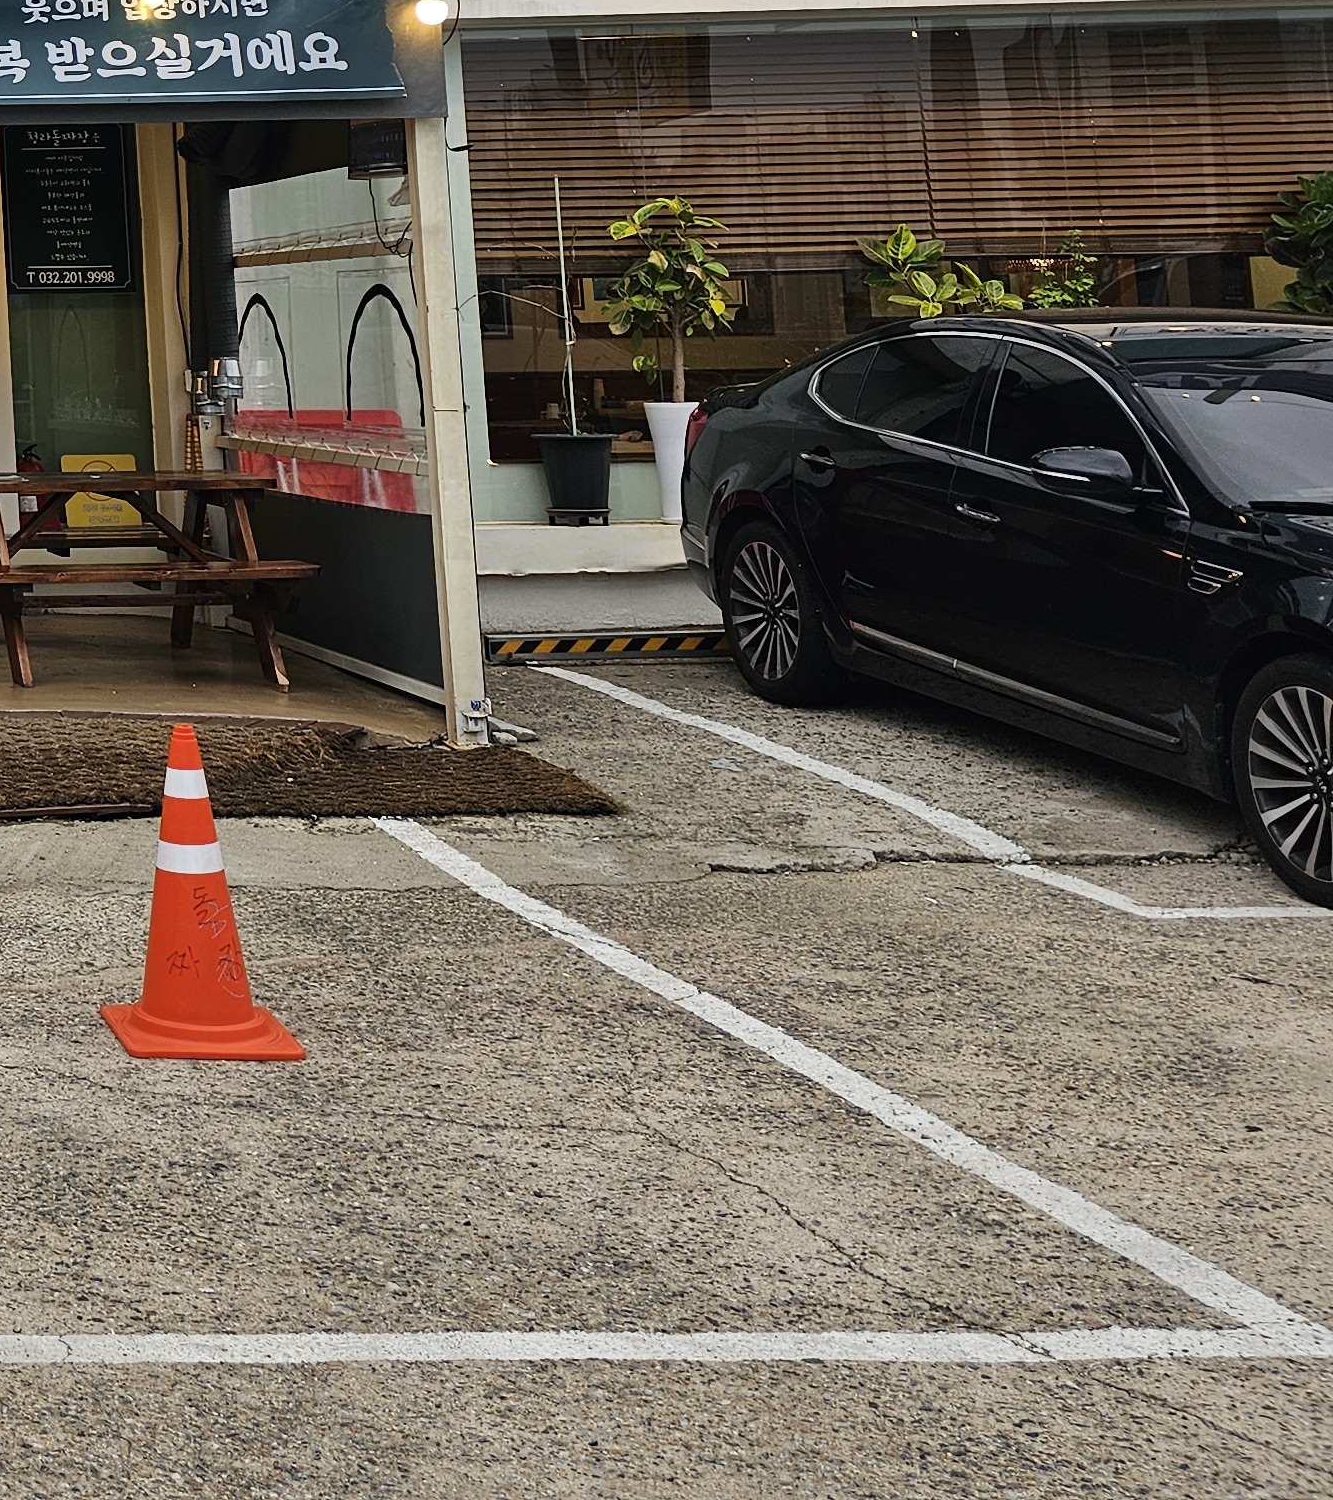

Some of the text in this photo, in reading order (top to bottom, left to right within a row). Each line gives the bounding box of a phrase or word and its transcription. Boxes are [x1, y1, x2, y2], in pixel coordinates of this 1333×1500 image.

[44, 30, 348, 84] 받으실거에요
[26, 270, 115, 284] T 032.201.9998
